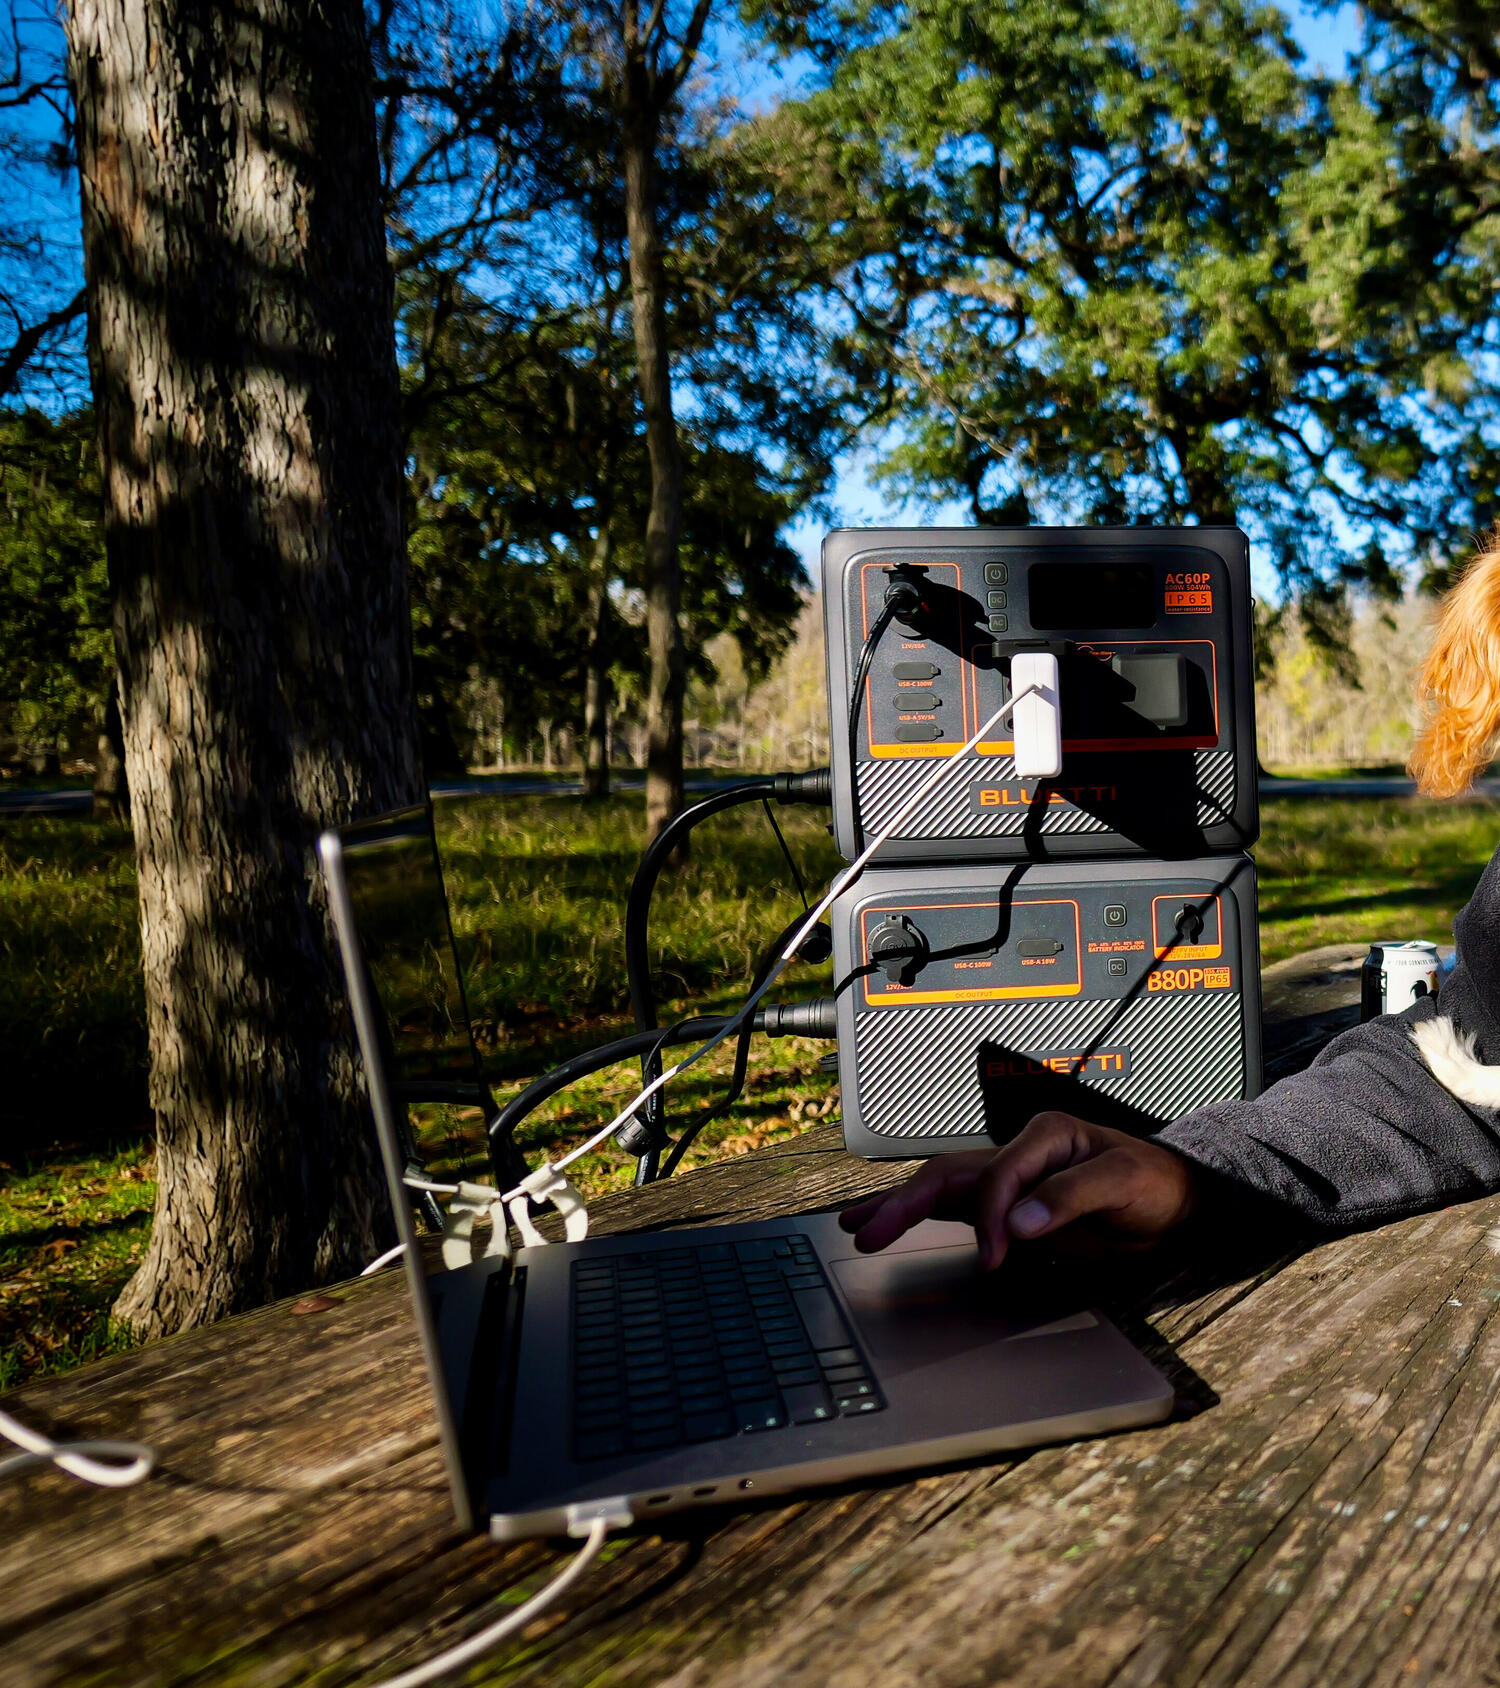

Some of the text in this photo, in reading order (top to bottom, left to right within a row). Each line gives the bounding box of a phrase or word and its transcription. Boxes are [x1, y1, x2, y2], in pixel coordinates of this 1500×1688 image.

[1165, 573, 1211, 585] AC60P
[898, 713, 917, 721] USB-A
[979, 785, 1116, 806] BLUETTI
[1113, 944, 1145, 952] INDICATOR
[954, 960, 992, 969] USB-C 100W
[1111, 963, 1122, 971] DC
[1147, 968, 1204, 991] B80P
[1205, 974, 1228, 984] IP65
[967, 990, 993, 998] OUTPUT
[987, 1053, 1123, 1077] BLUETTI
